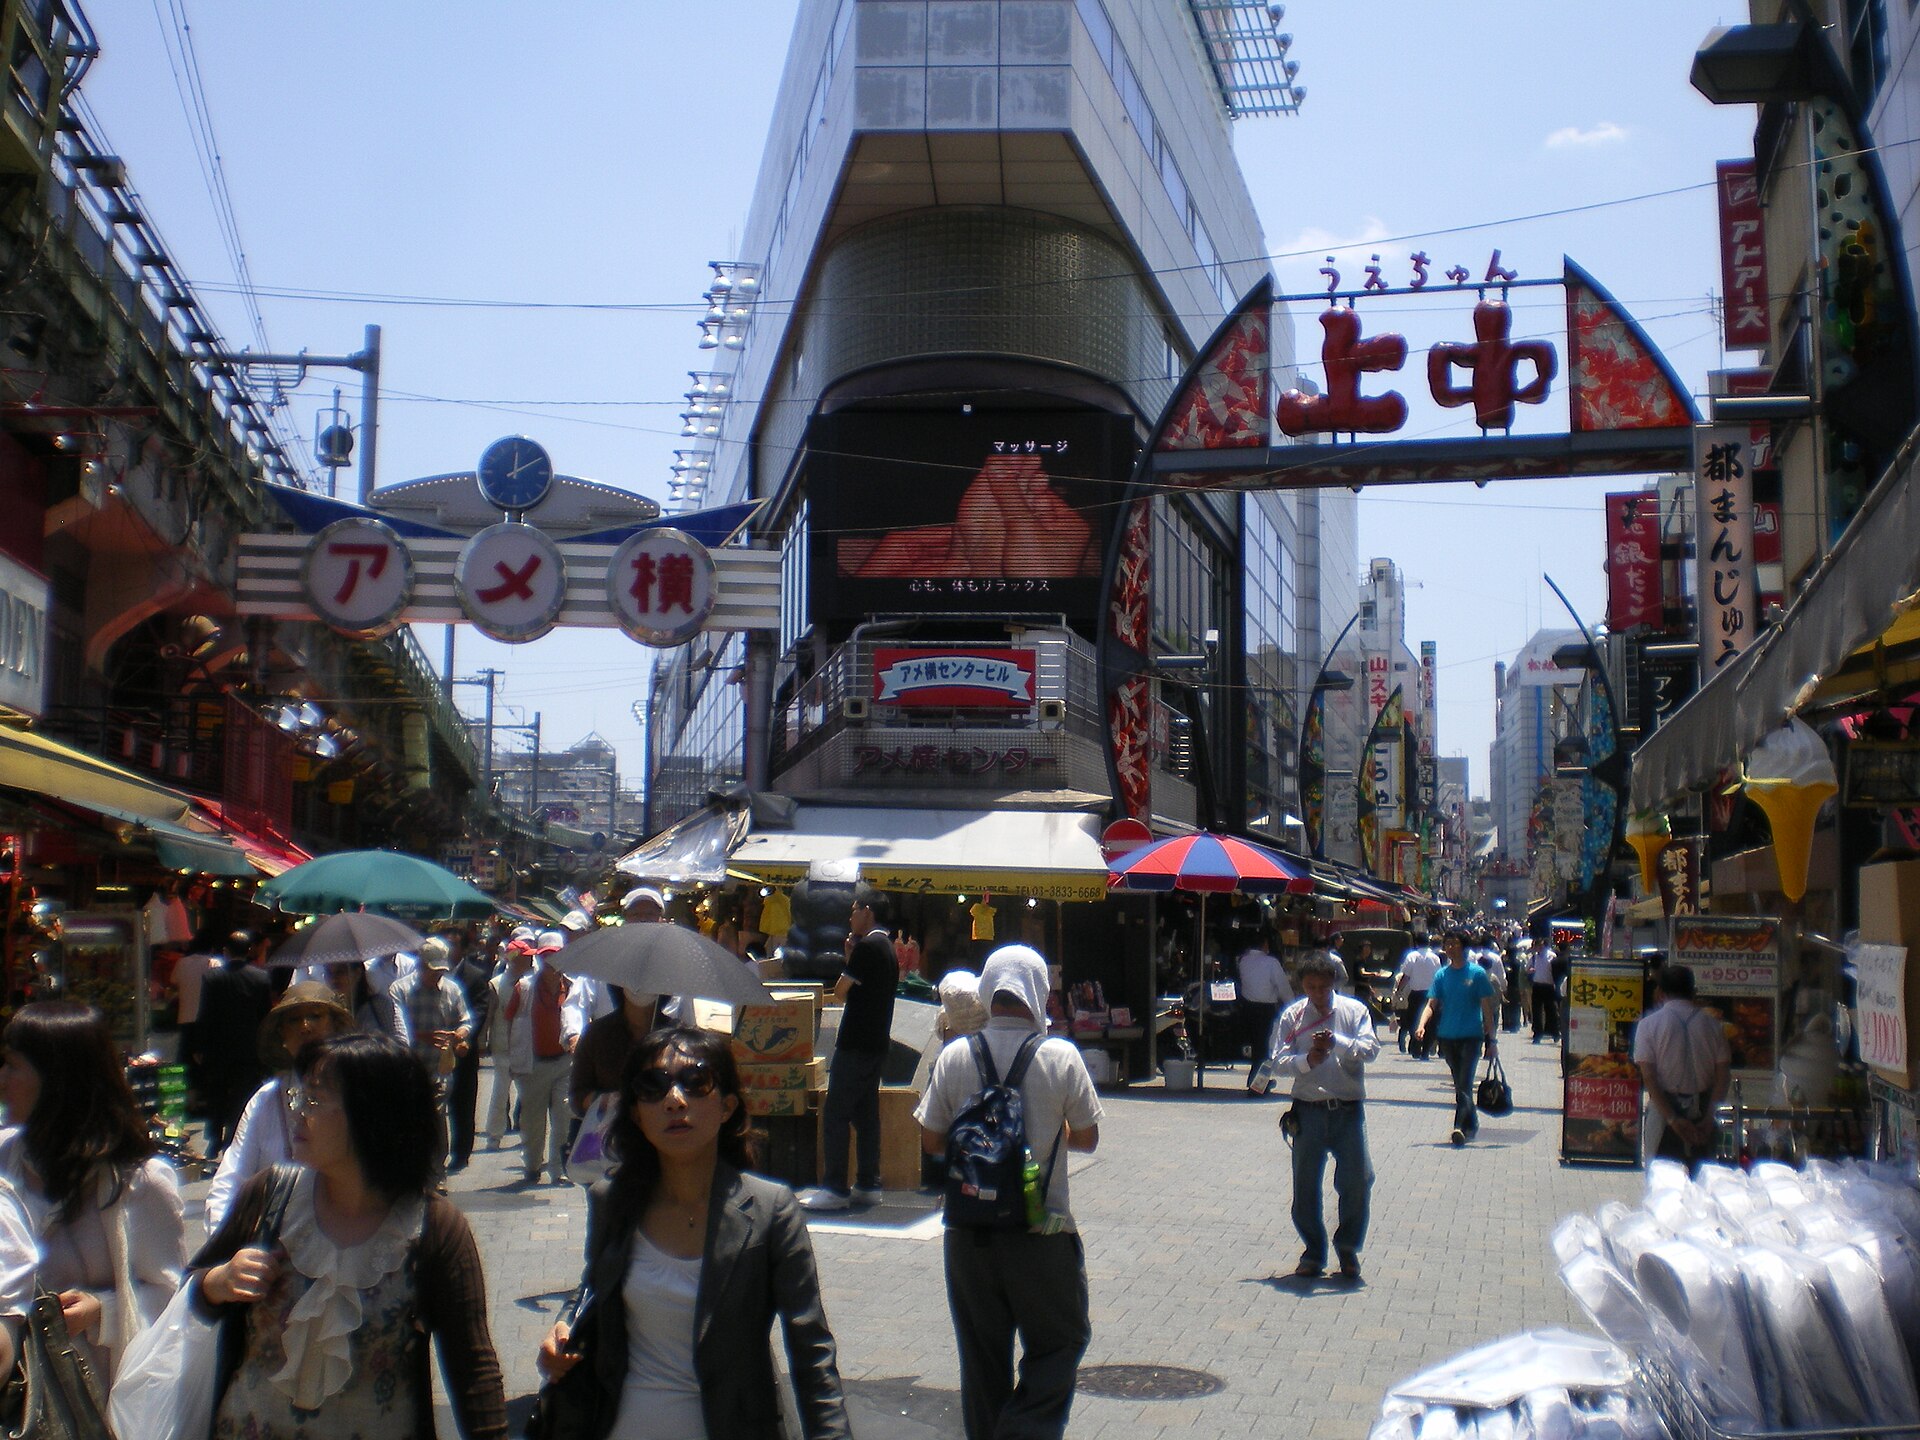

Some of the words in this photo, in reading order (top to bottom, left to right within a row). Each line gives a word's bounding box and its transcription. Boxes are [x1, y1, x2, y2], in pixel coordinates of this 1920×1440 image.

[1319, 248, 1519, 292] うえちゅん
[1278, 298, 1558, 437] 上中
[993, 440, 1068, 453] マッサージ
[1702, 442, 1745, 668] 都まんじゅう
[328, 543, 695, 614] アメ横
[909, 579, 1050, 592] 心も、体もリラックス
[899, 661, 1010, 683] アメ横センタービル
[853, 745, 1058, 774] アメ横センター
[1663, 847, 1695, 916] 都まん
[1572, 979, 1634, 1006] 串かつ
